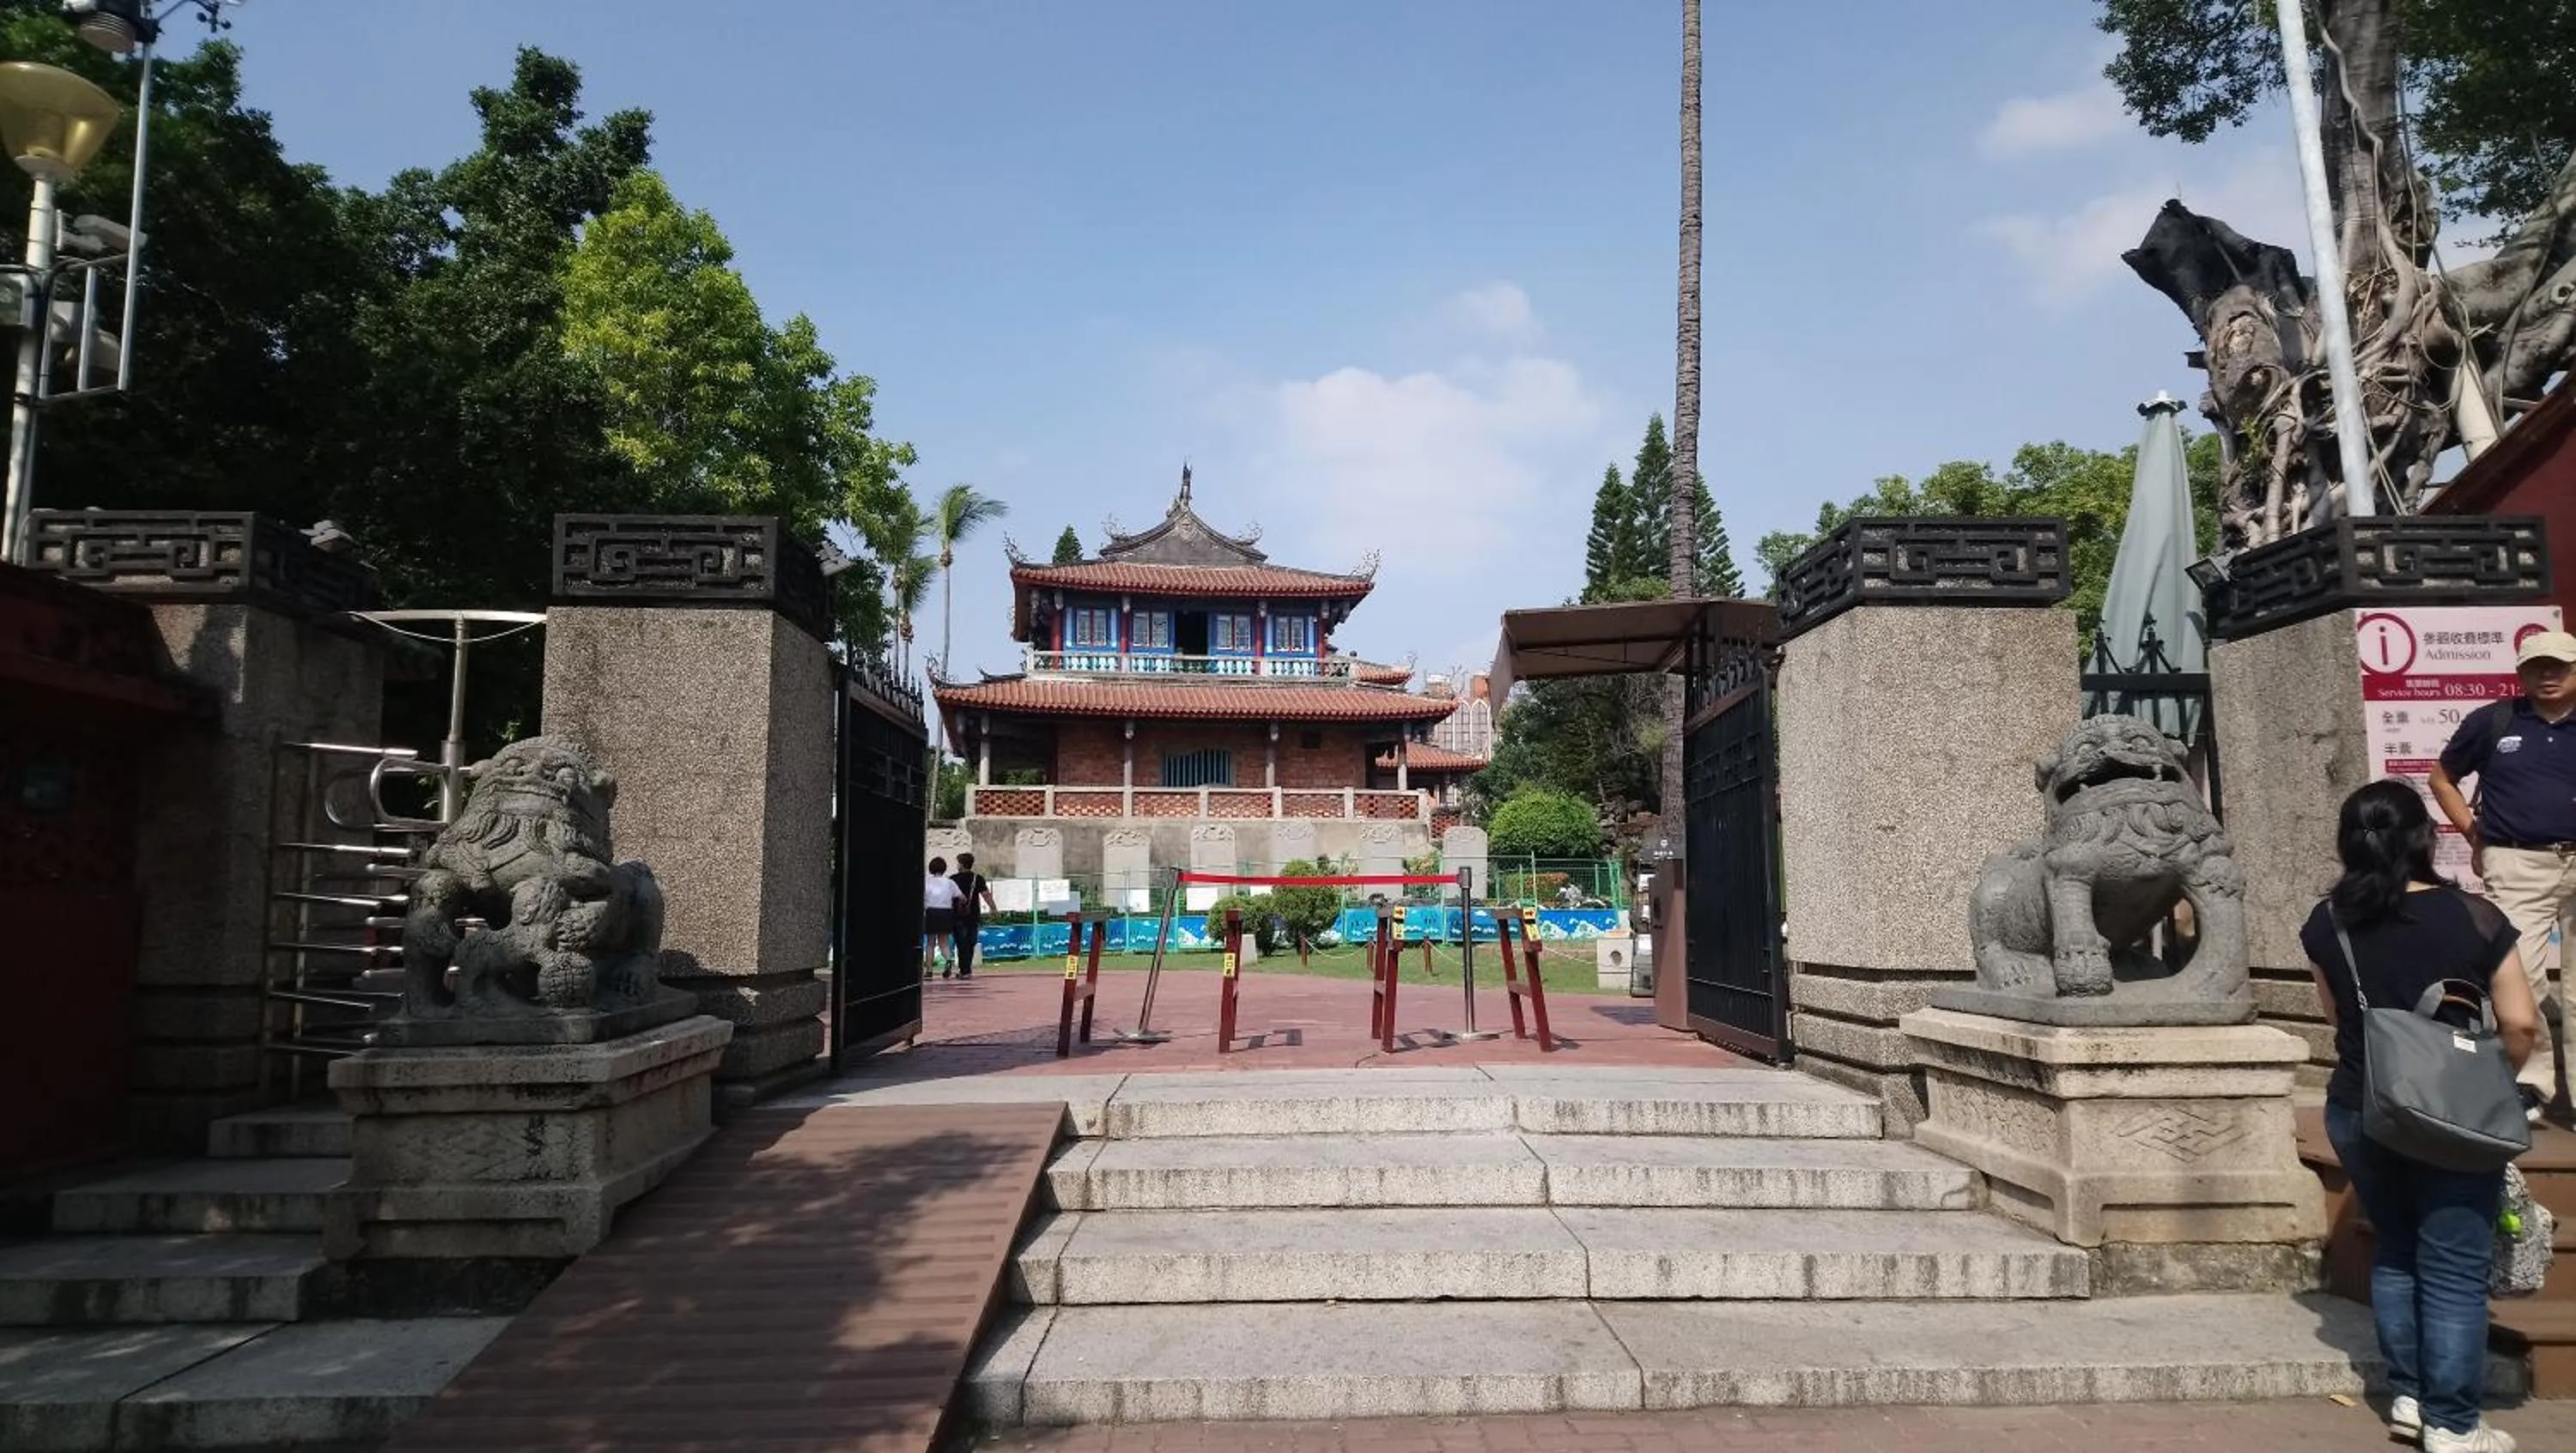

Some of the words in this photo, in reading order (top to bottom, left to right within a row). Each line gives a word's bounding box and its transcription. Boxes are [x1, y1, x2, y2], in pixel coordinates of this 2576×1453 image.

[2425, 648, 2491, 660] Admission
[2414, 687, 2441, 697] hours
[2439, 708, 2461, 725] 50
